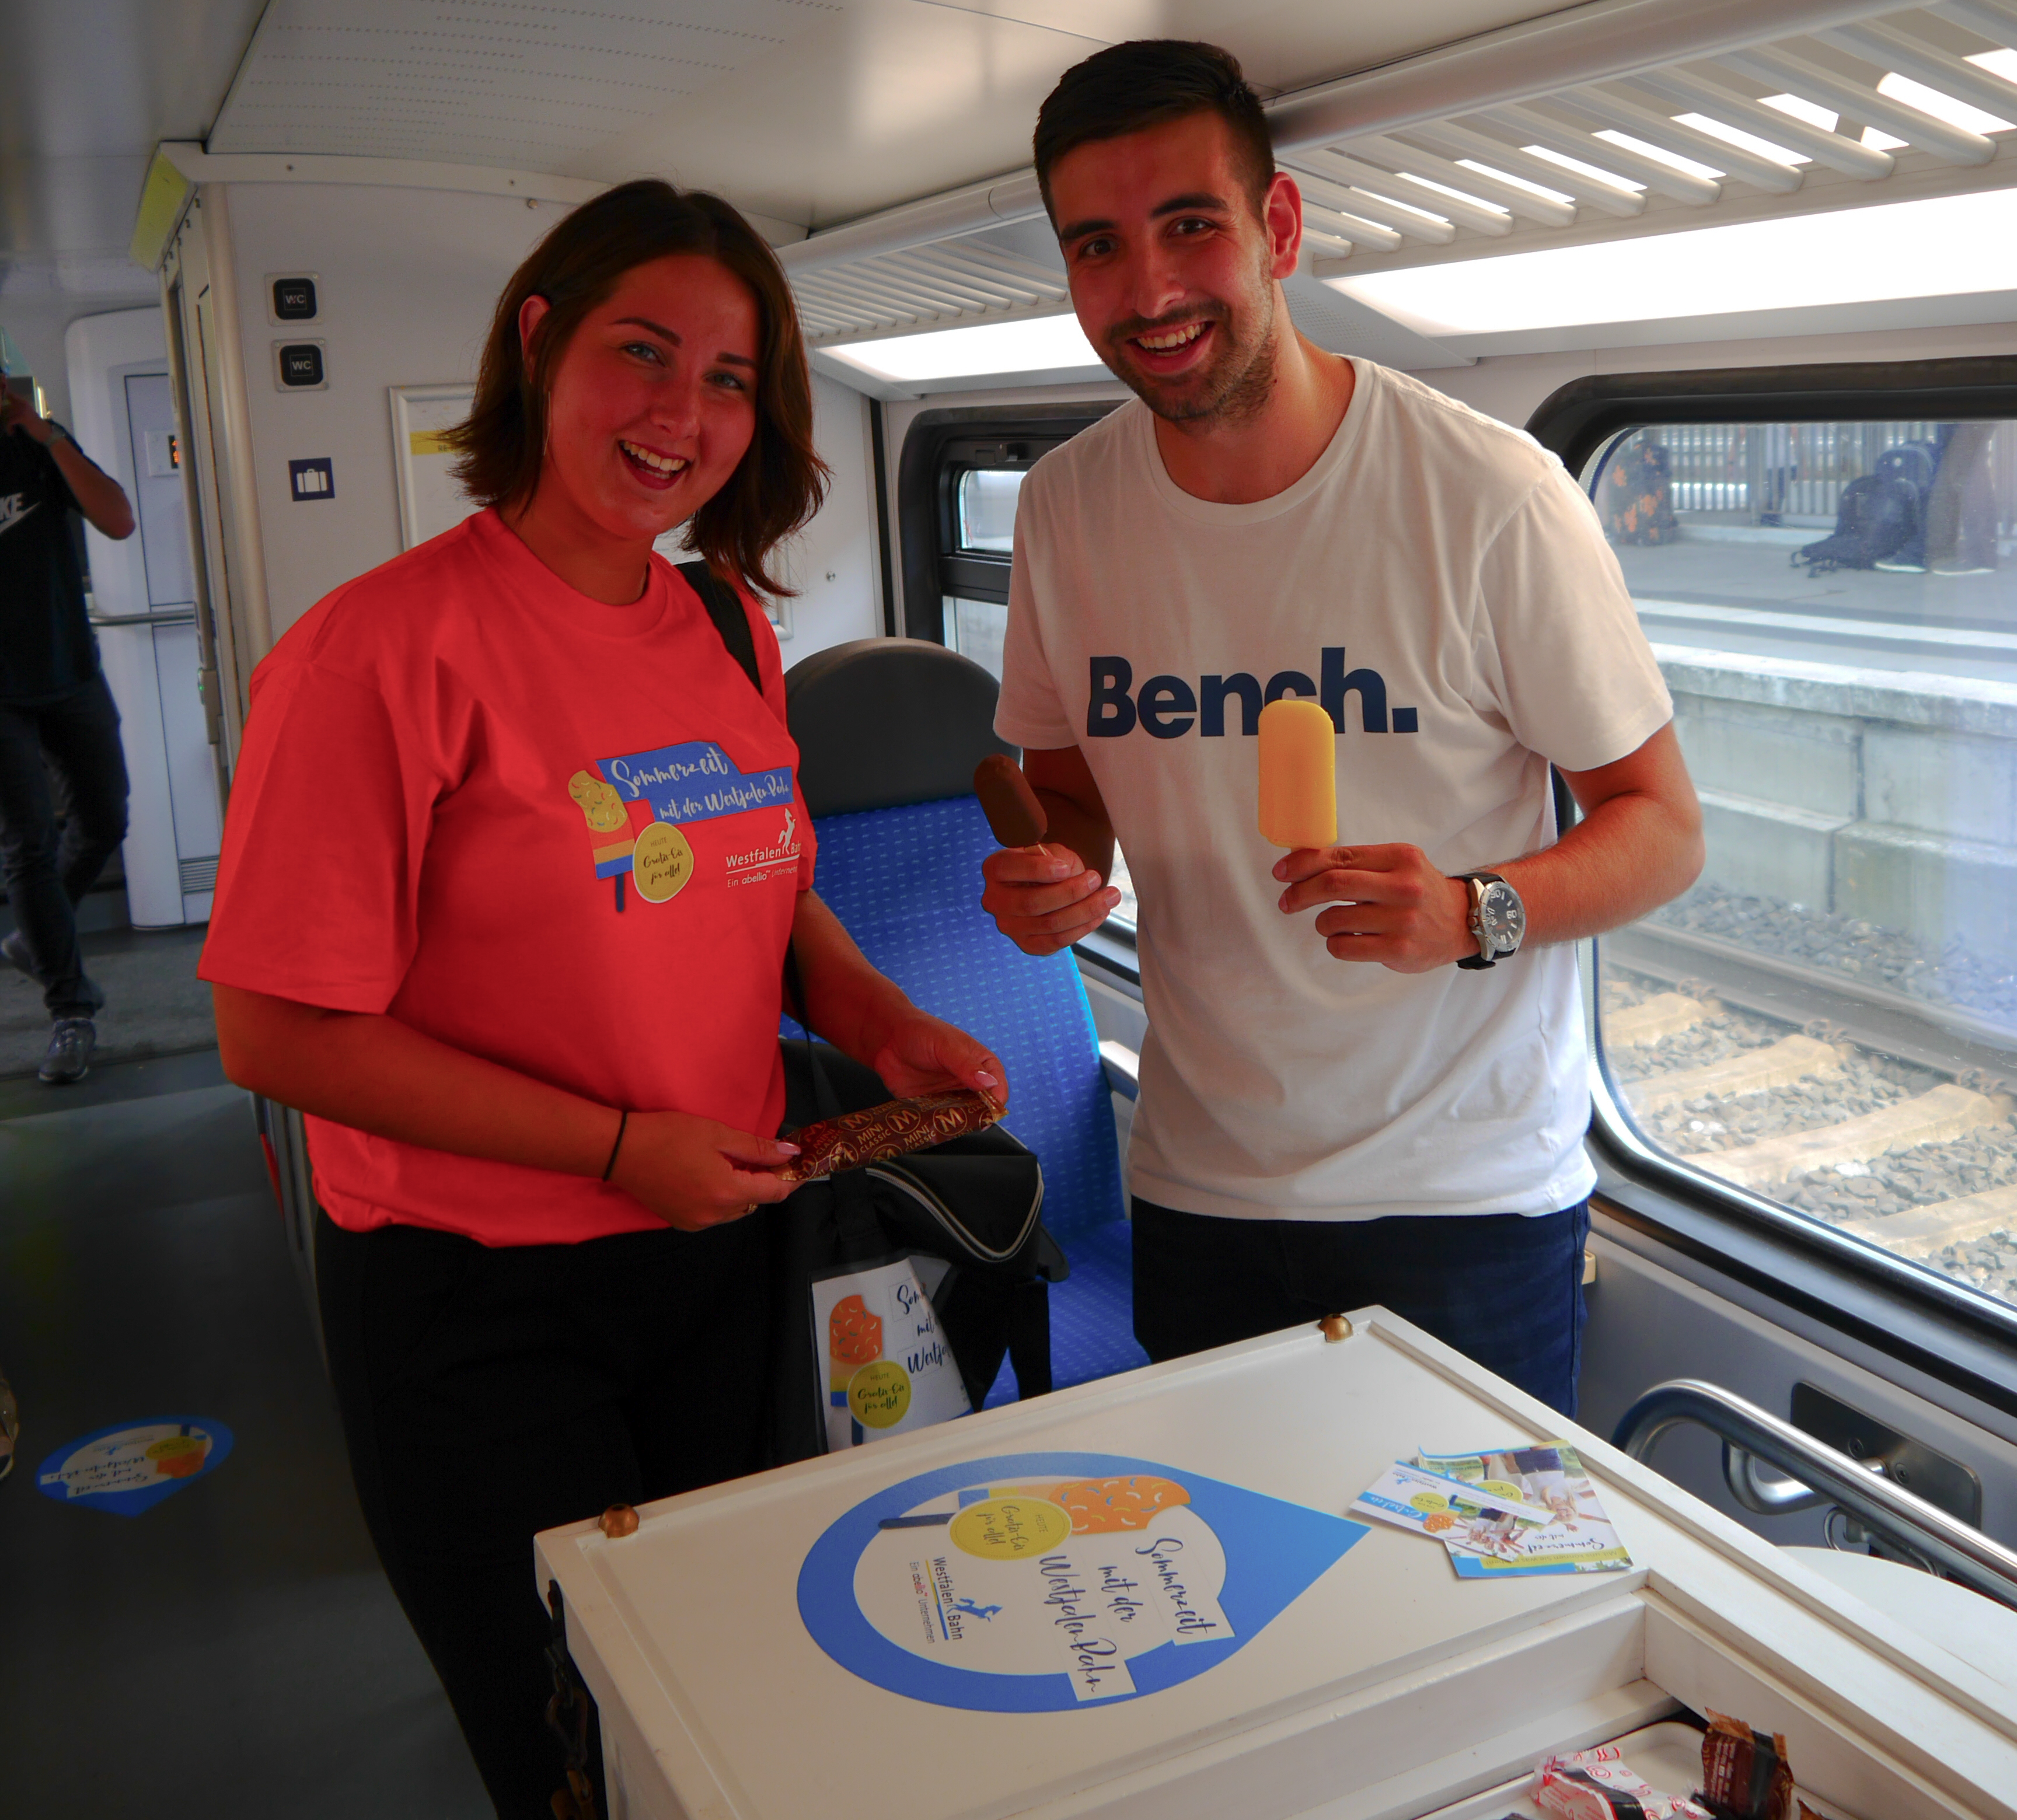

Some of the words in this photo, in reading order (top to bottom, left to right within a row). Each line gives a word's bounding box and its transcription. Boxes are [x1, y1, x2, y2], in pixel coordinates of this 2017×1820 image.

[285, 294, 305, 304] WC
[292, 360, 312, 370] WC
[0, 491, 25, 522] KE
[610, 746, 728, 798] Sommerzeit
[659, 798, 681, 819] mit
[683, 797, 703, 817] der
[650, 836, 667, 847] HEUTE
[725, 847, 781, 868] Westfalen
[651, 872, 662, 885] für
[665, 862, 680, 878] alle!
[727, 879, 738, 888] Ein
[742, 871, 768, 885] abellio
[772, 865, 797, 878] Unterneh
[843, 1113, 870, 1129] M
[889, 1109, 918, 1131] M
[935, 1108, 965, 1133] M
[813, 1129, 836, 1149] MINI
[816, 1130, 843, 1155] CLASSIC
[857, 1123, 884, 1145] MINI
[860, 1129, 891, 1153] CLASSIC
[903, 1124, 930, 1147] MINI
[906, 1130, 936, 1152] CLASSIC
[917, 1312, 934, 1337] mit
[908, 1342, 951, 1374] Westfa
[870, 1373, 890, 1381] HEUTE
[864, 1402, 878, 1414] für
[976, 1513, 994, 1526] für
[1001, 1505, 1029, 1550] Gratis-Eis
[1035, 1514, 1048, 1533] HEUTE
[983, 1527, 1006, 1545] alle!
[909, 1562, 919, 1572] Ein
[912, 1573, 926, 1595] abellio
[1098, 1566, 1138, 1593] mit
[1135, 1538, 1217, 1634] Sommerzeit
[933, 1556, 955, 1604] Westfalen
[947, 1615, 965, 1640] Bahn
[918, 1598, 935, 1644] Unternehmen
[1107, 1597, 1144, 1623] der
